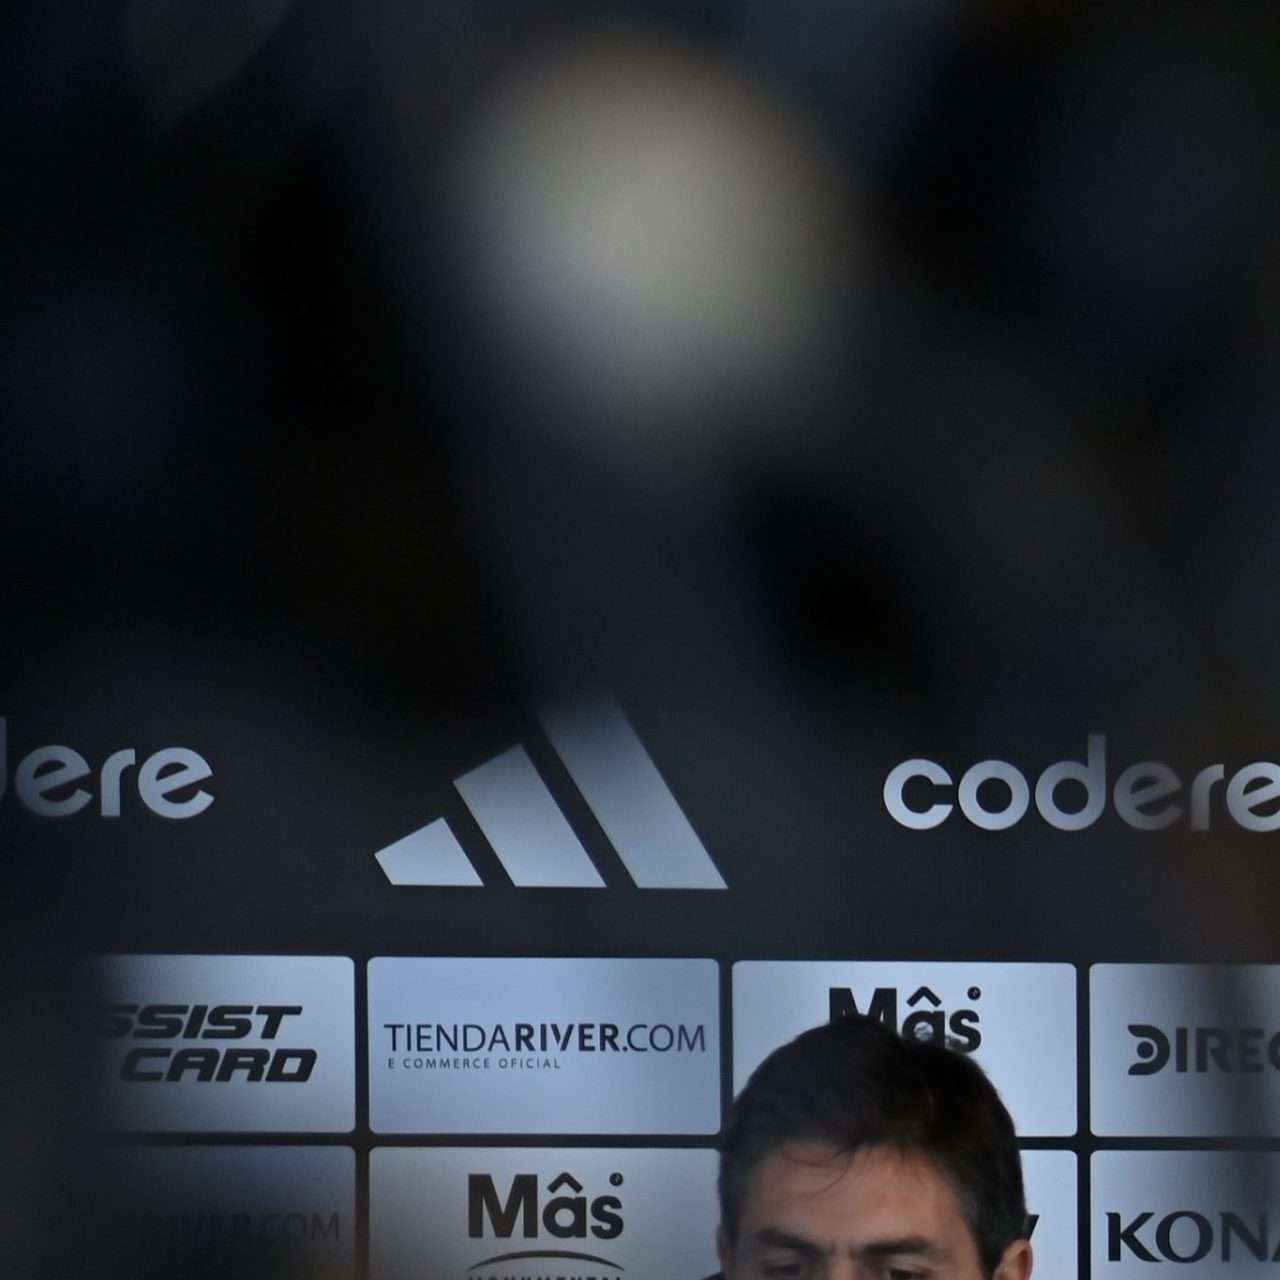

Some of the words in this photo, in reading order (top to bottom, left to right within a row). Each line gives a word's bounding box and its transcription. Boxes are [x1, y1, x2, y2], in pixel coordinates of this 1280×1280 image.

[0, 716, 215, 820] ere
[106, 1004, 303, 1041] SSIST
[383, 1023, 706, 1053] TIENDARIVER.COM
[121, 1047, 317, 1083] CARD
[387, 1057, 395, 1070] E
[402, 1057, 491, 1070] COMMERCE
[498, 1057, 560, 1070] OFICIAL
[467, 1172, 625, 1240] Mâs
